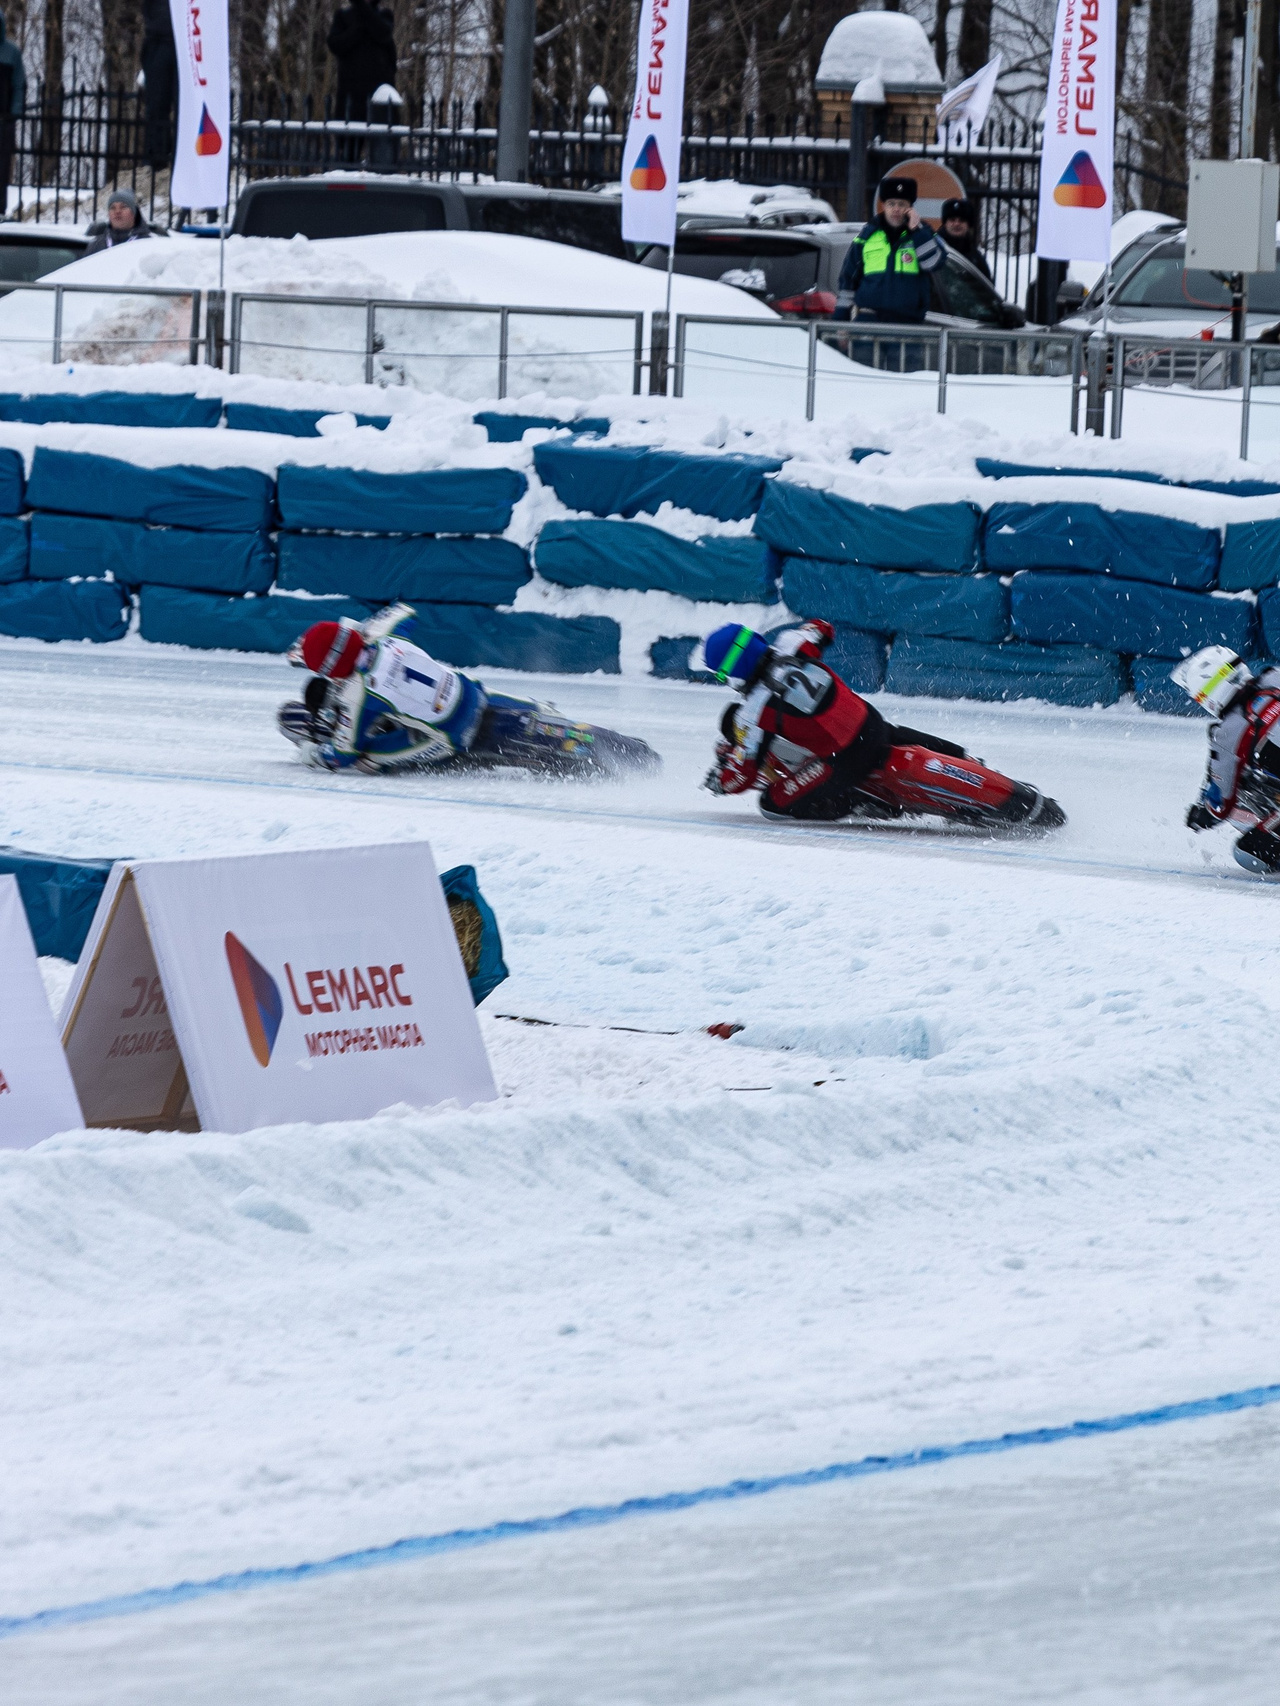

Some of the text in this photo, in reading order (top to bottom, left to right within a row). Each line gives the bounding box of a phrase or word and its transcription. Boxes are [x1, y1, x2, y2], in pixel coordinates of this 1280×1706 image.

[402, 664, 438, 690] 1
[785, 669, 827, 702] 2
[284, 962, 413, 1016] LEMARC
[304, 1023, 426, 1058] МОТОРНЫЕ МАСЛА
